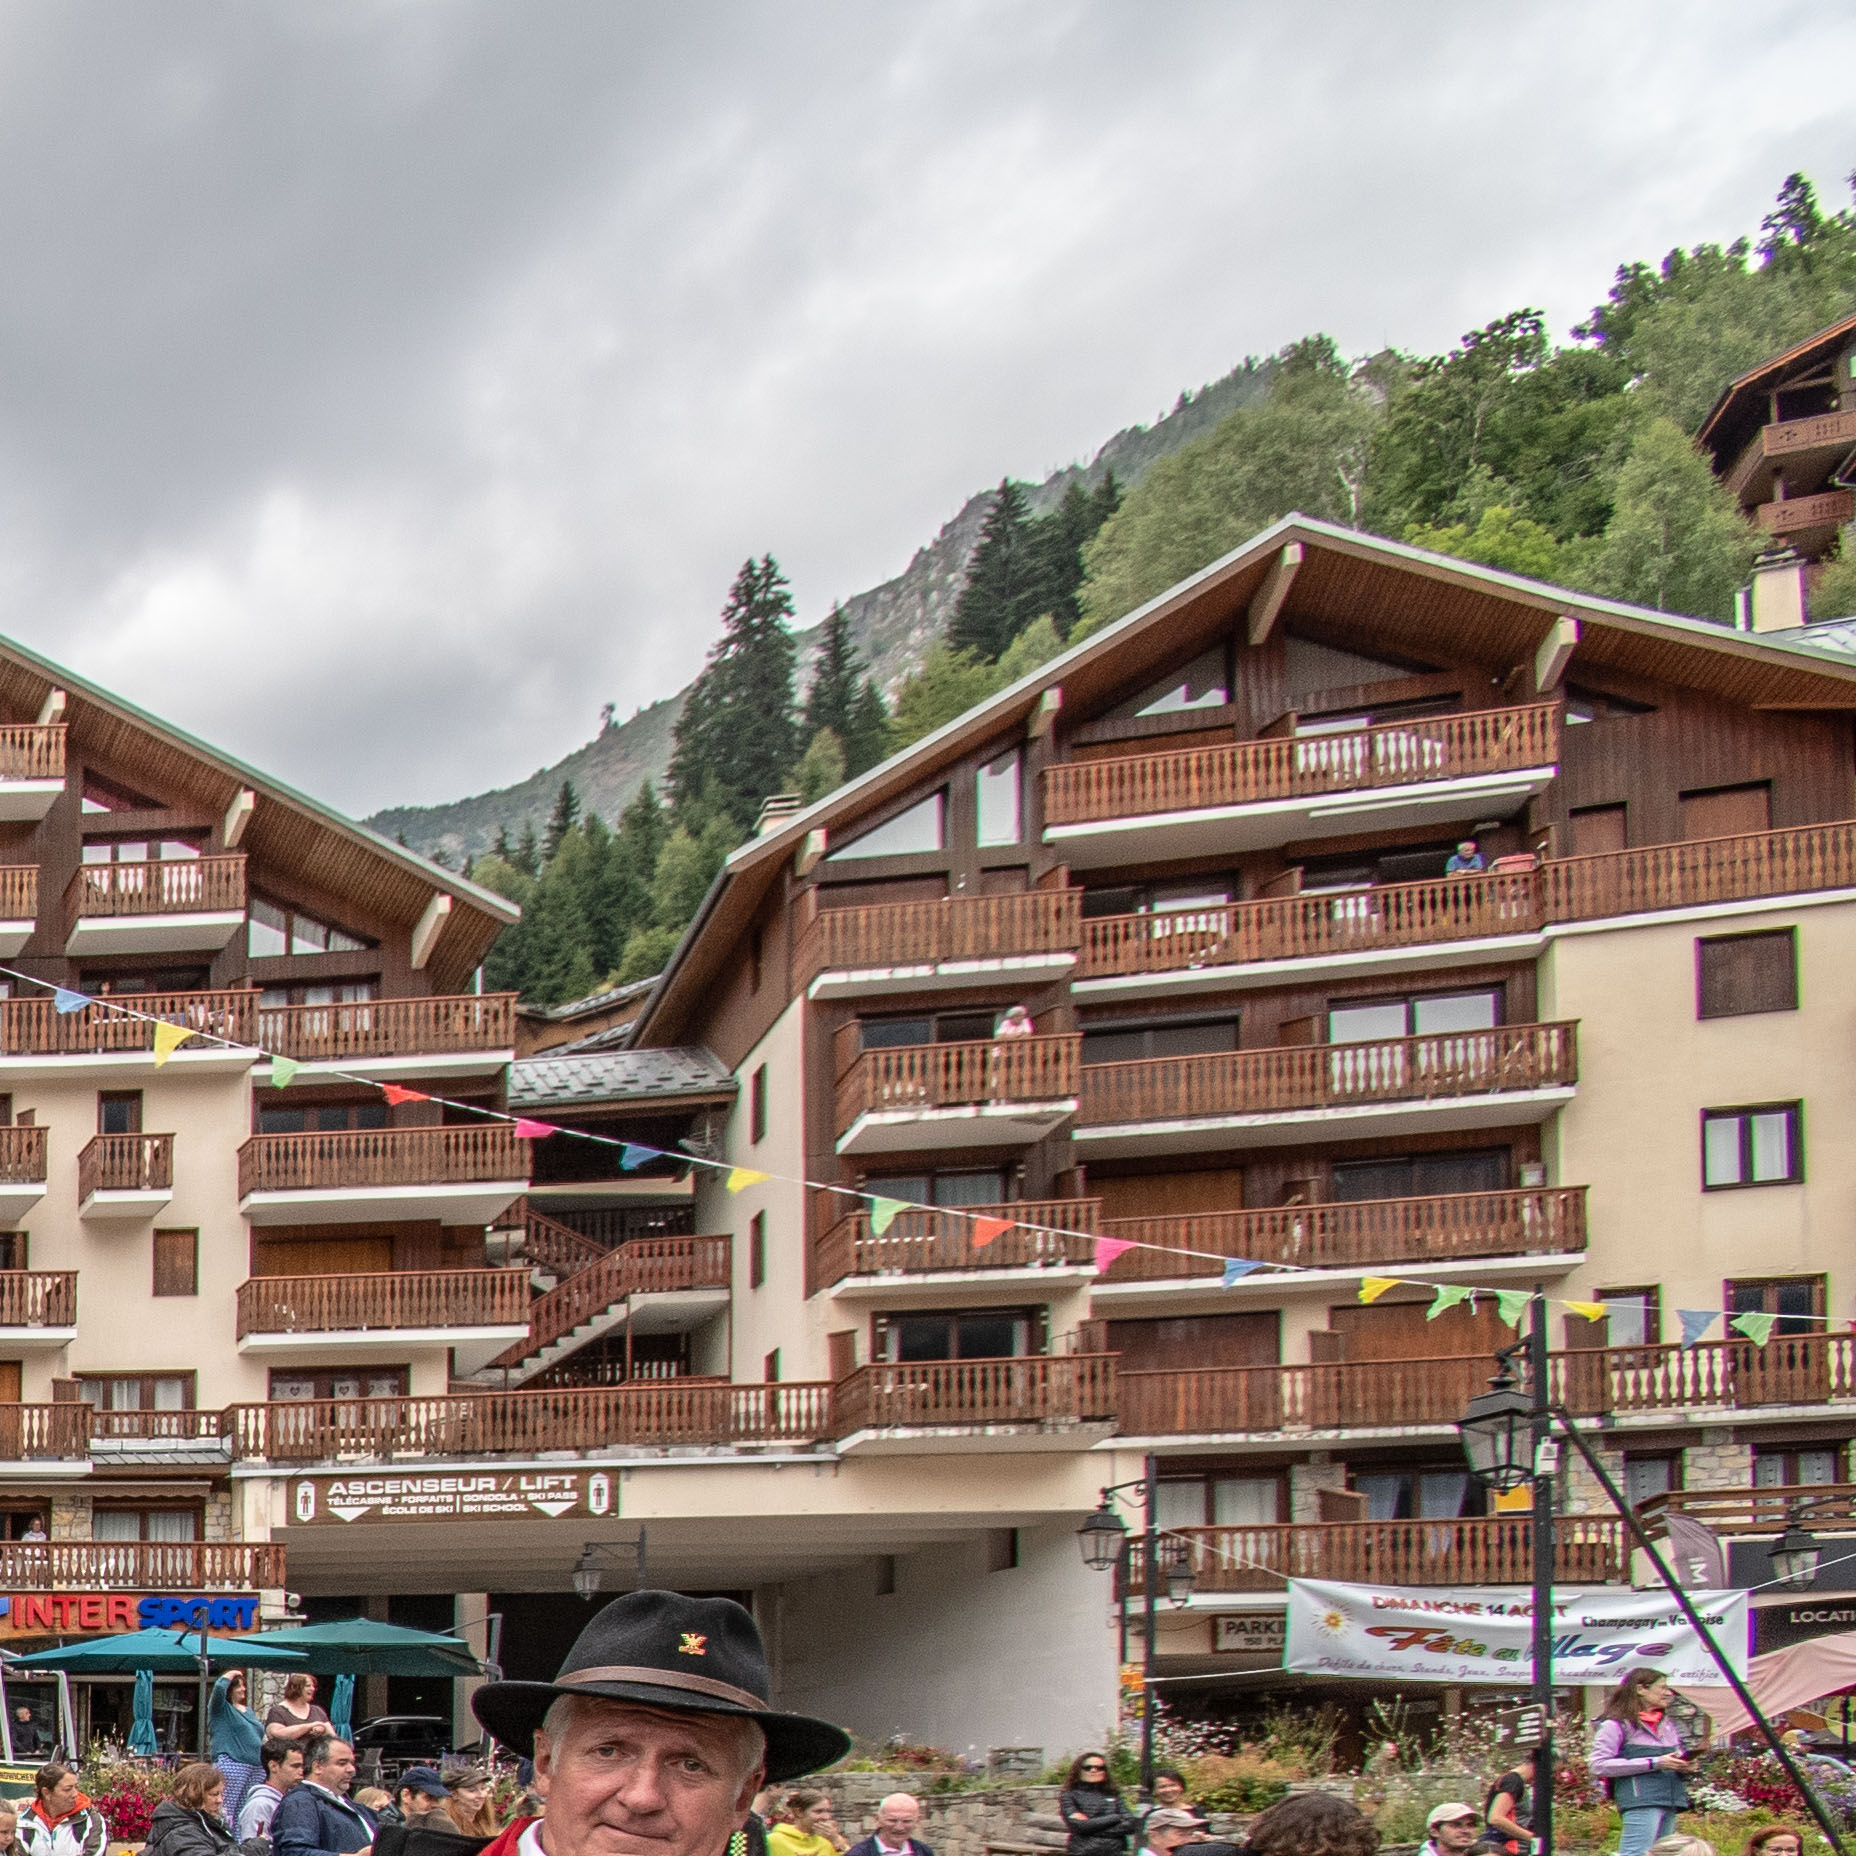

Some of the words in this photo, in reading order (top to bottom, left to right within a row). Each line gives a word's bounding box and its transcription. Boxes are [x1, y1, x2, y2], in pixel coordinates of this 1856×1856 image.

[327, 1477, 496, 1496] ASCENSEUR
[520, 1475, 578, 1491] LIFT
[327, 1495, 393, 1506] TÉLÉCABINE
[401, 1494, 454, 1504] FORFAITS
[462, 1493, 519, 1502] GONDOLA
[547, 1491, 578, 1500] PASS
[482, 1503, 529, 1513] SCHOOL
[1372, 1596, 1483, 1616] DIMANCHE
[1486, 1604, 1506, 1615] 14
[1507, 1604, 1568, 1617] AOT
[1225, 1620, 1286, 1635] PARKI
[1668, 1613, 1724, 1627] Vaoise
[1365, 1626, 1488, 1657] Fête
